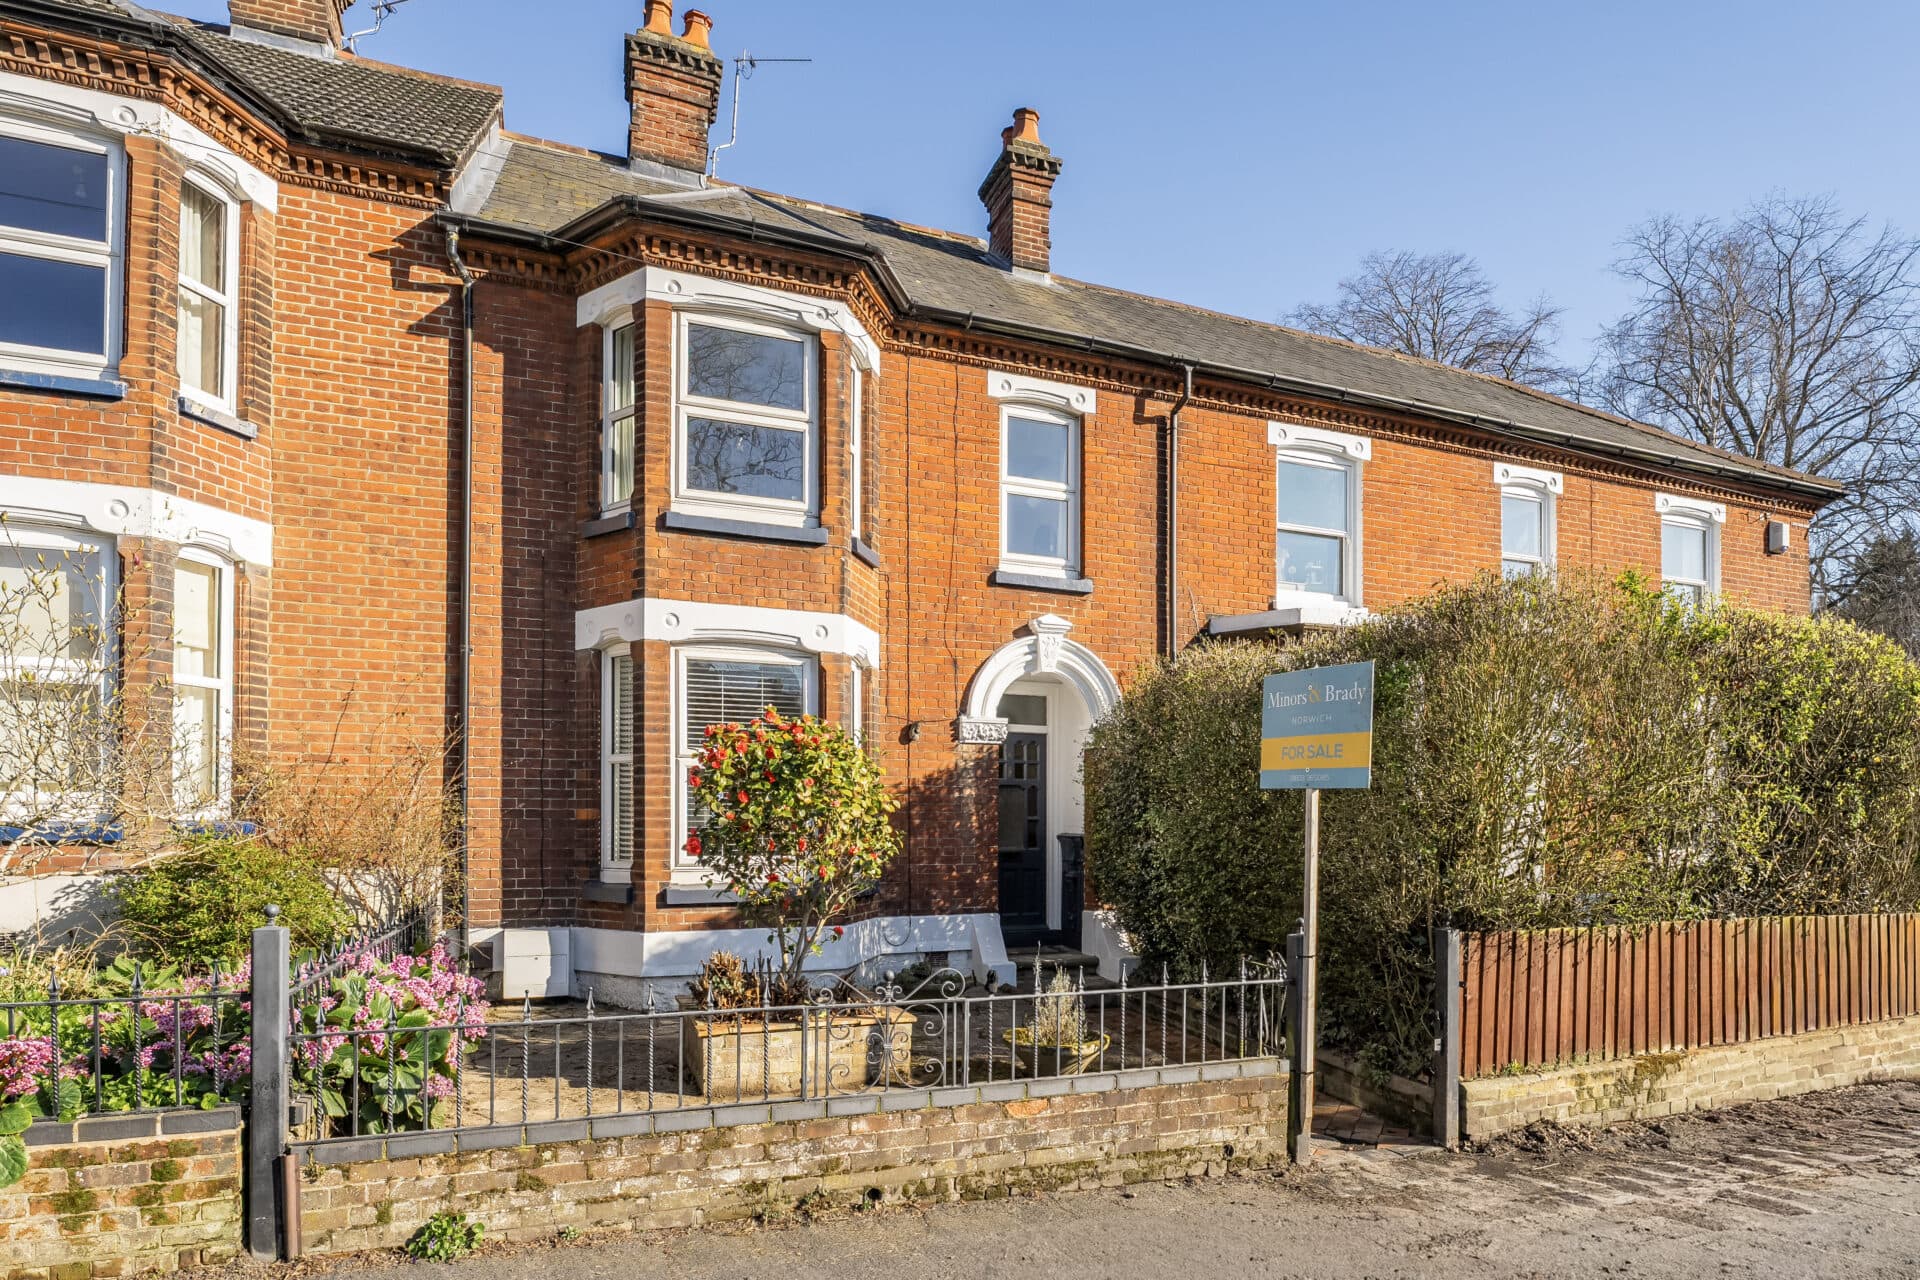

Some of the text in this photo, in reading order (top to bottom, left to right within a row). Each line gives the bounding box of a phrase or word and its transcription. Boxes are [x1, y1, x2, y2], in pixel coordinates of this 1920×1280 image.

[1268, 681, 1366, 709] Minors & Brady
[1292, 714, 1333, 726] NORWICH
[1281, 743, 1344, 761] FOR SALE
